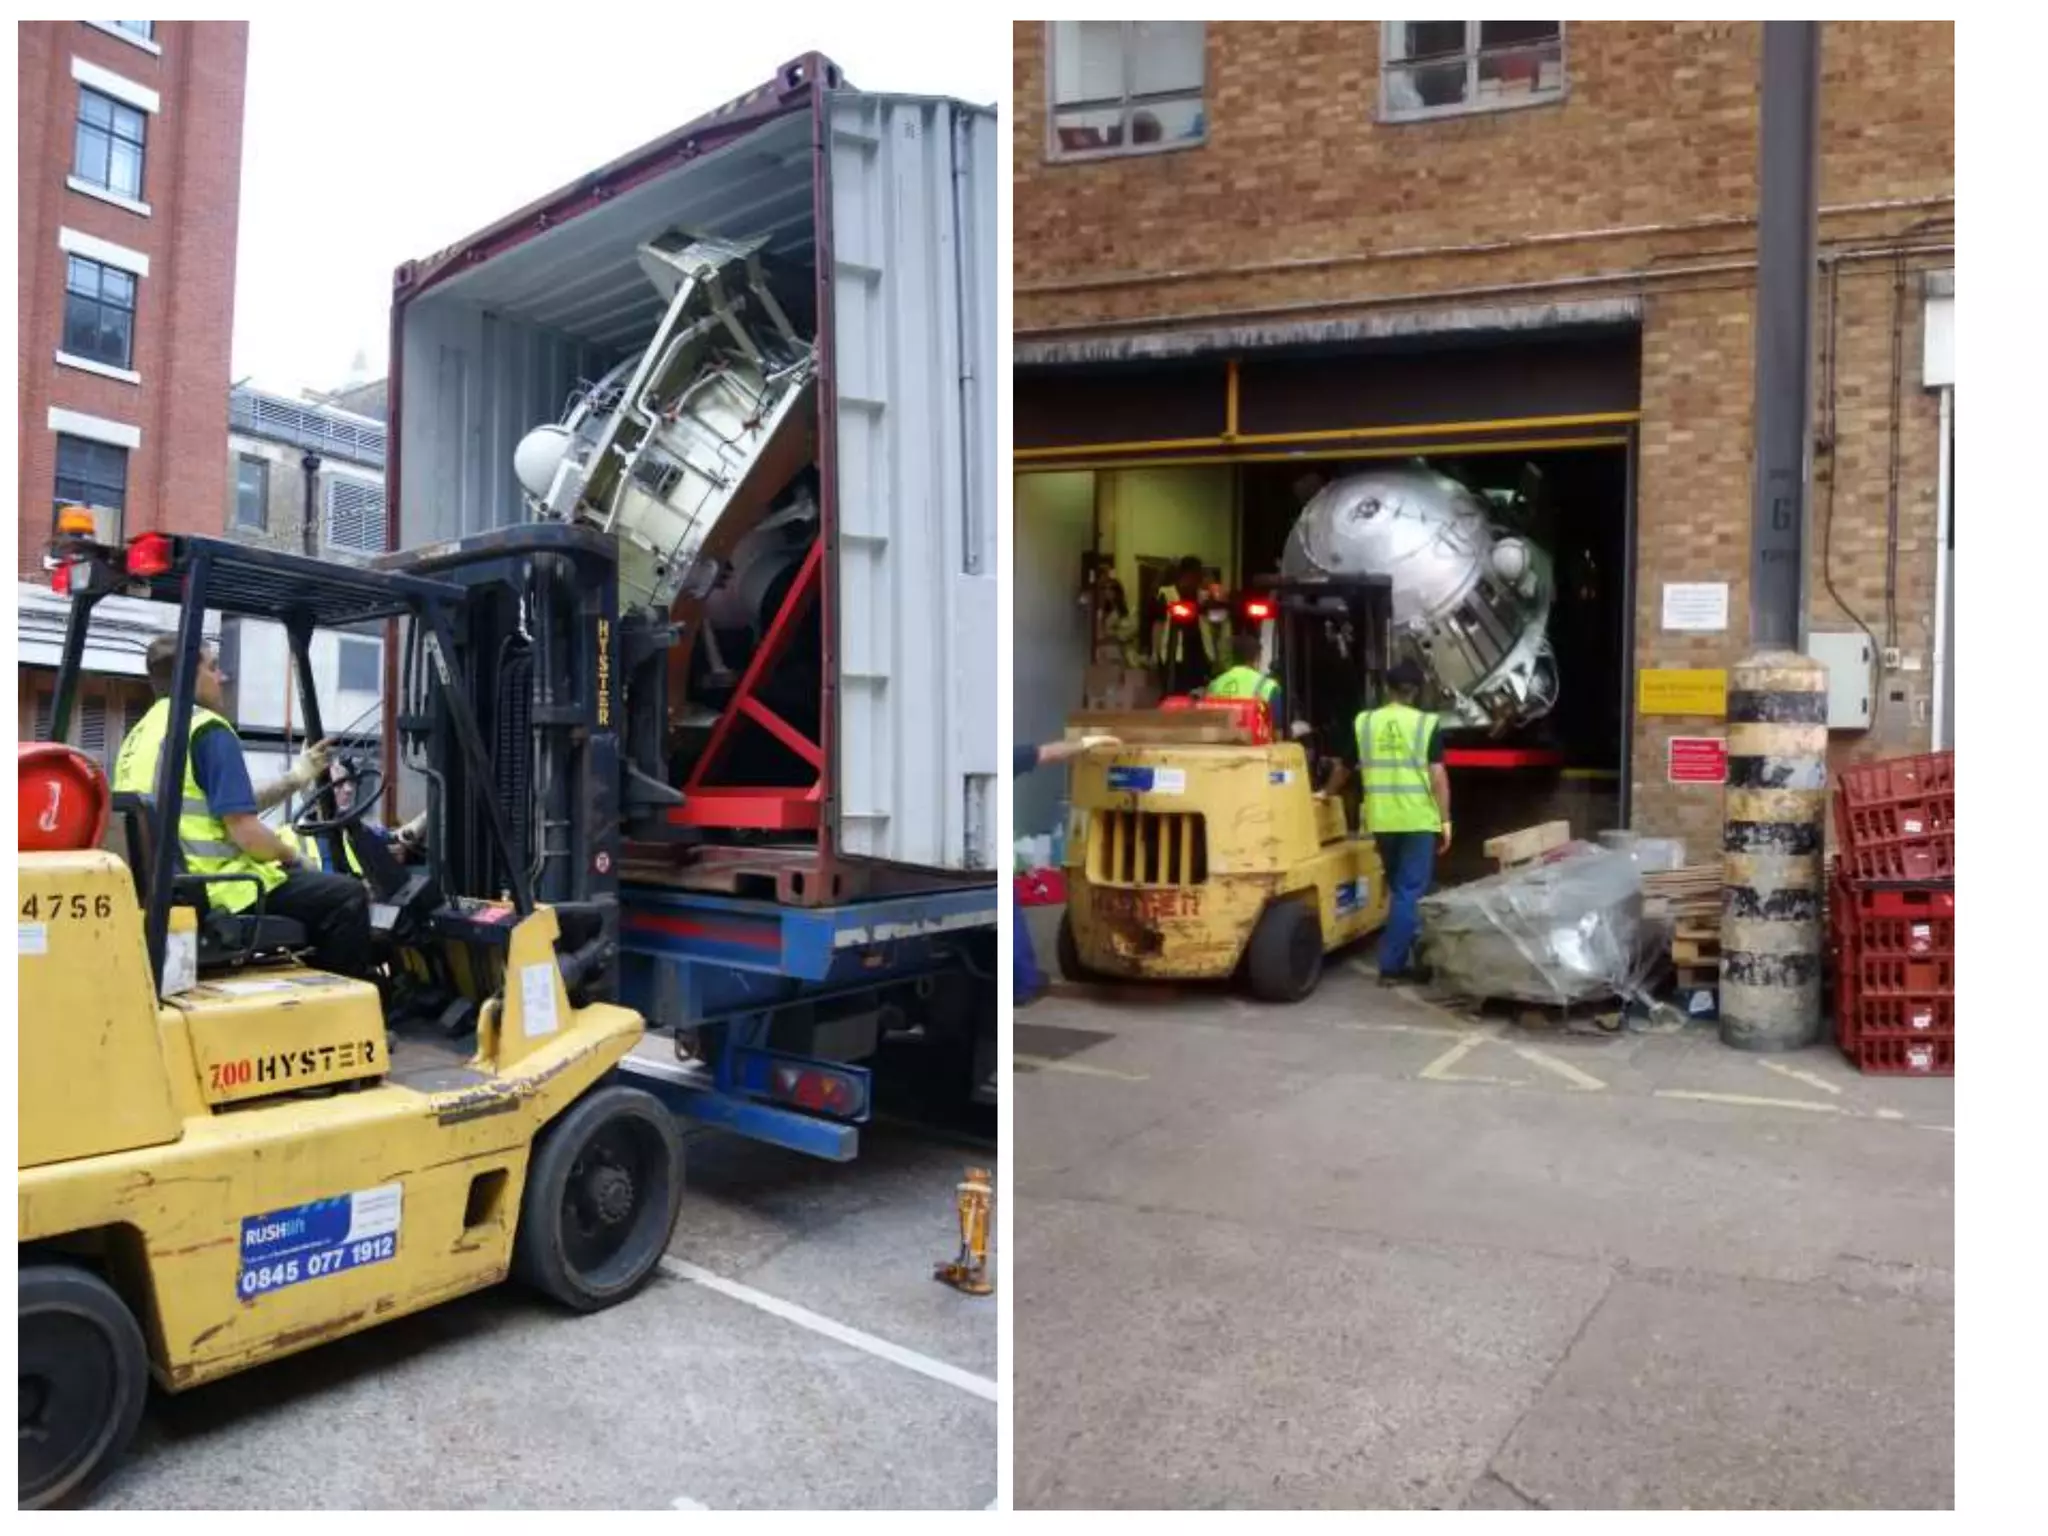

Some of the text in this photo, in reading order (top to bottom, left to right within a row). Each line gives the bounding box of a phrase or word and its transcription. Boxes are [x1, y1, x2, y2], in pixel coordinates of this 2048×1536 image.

[598, 618, 609, 726] HYSTER
[21, 894, 112, 919] 4756
[208, 1039, 374, 1090] 700 HYSTER
[242, 1259, 300, 1293] 0845
[307, 1248, 344, 1276] 077
[351, 1235, 393, 1264] 1912
